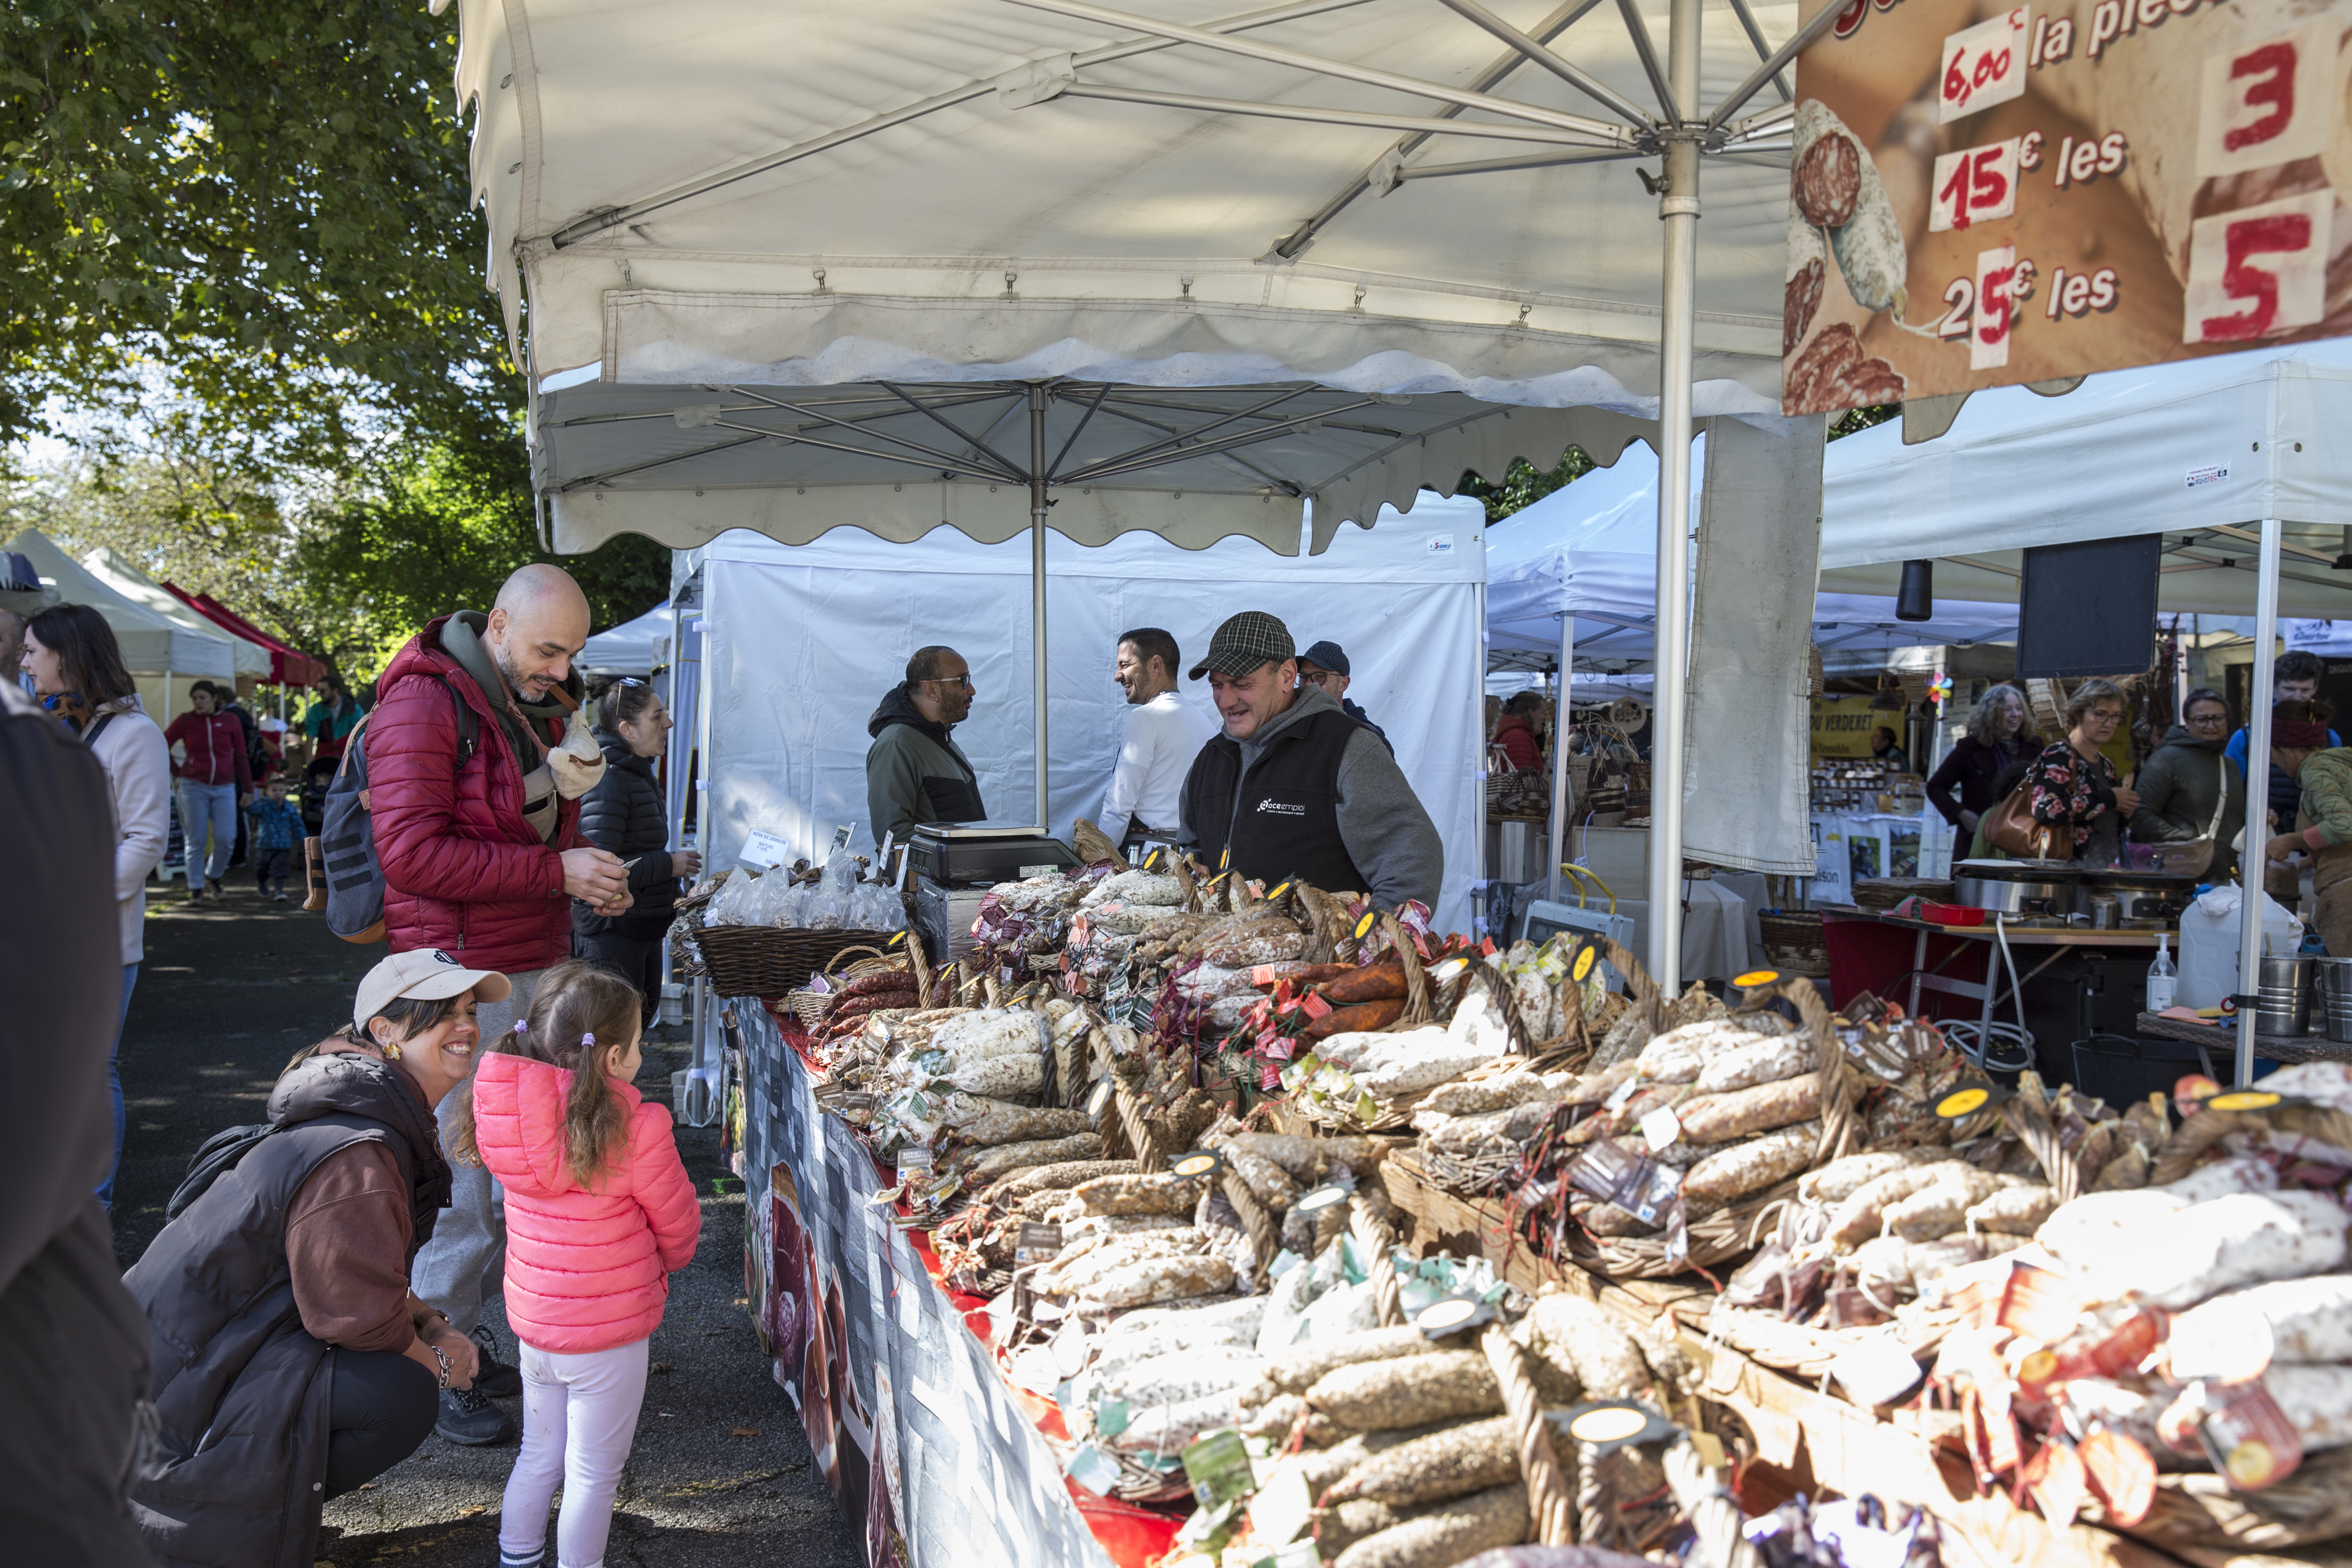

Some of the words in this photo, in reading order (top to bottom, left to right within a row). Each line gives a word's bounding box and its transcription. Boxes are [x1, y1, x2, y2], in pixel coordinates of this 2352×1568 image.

[2029, 14, 2072, 68] la
[2055, 131, 2124, 187] les
[2224, 41, 2297, 153] 3
[2046, 267, 2116, 319] les
[2201, 213, 2312, 343] 5
[759, 841, 774, 850] NATURE
[769, 836, 786, 845] JAMBON
